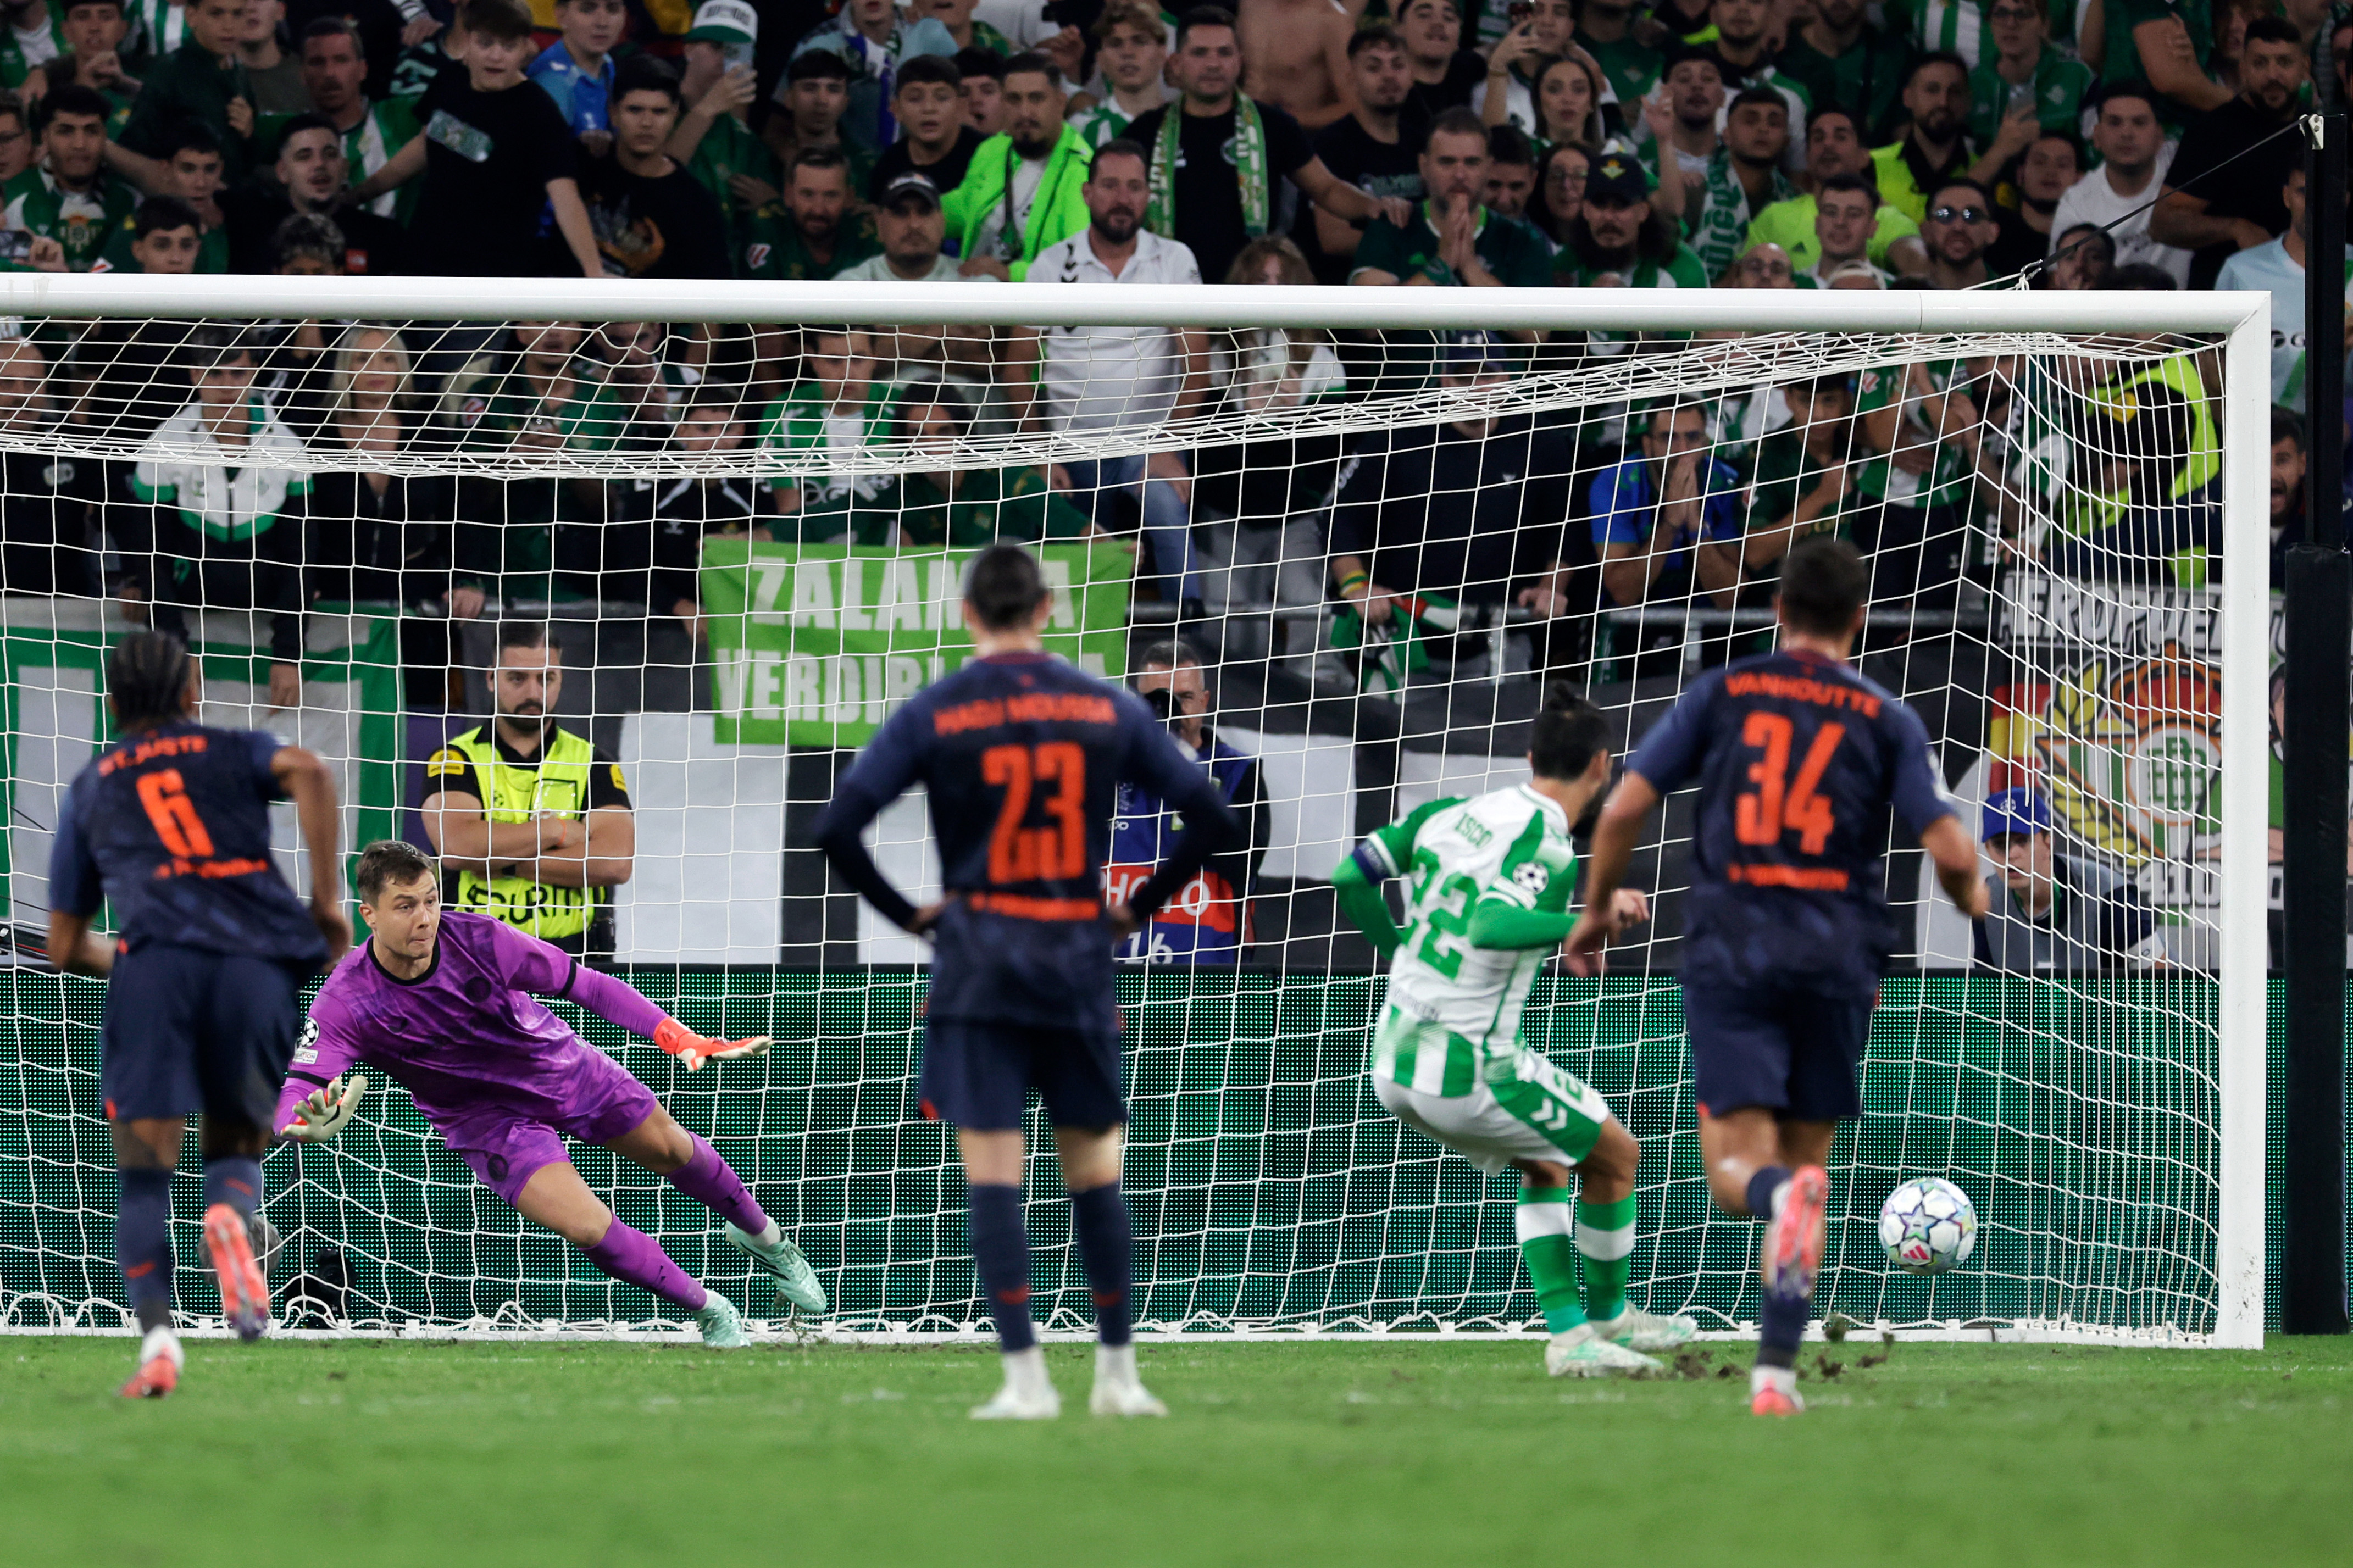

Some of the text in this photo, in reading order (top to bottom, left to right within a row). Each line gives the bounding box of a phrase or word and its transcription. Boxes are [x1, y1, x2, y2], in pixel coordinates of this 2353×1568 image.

[751, 556, 1075, 631] ZALAMA
[136, 767, 215, 859] 6
[981, 740, 1086, 885] 23
[1734, 710, 1846, 857] 34
[1455, 812, 1494, 849] ISCO
[1126, 932, 1174, 965] 16
